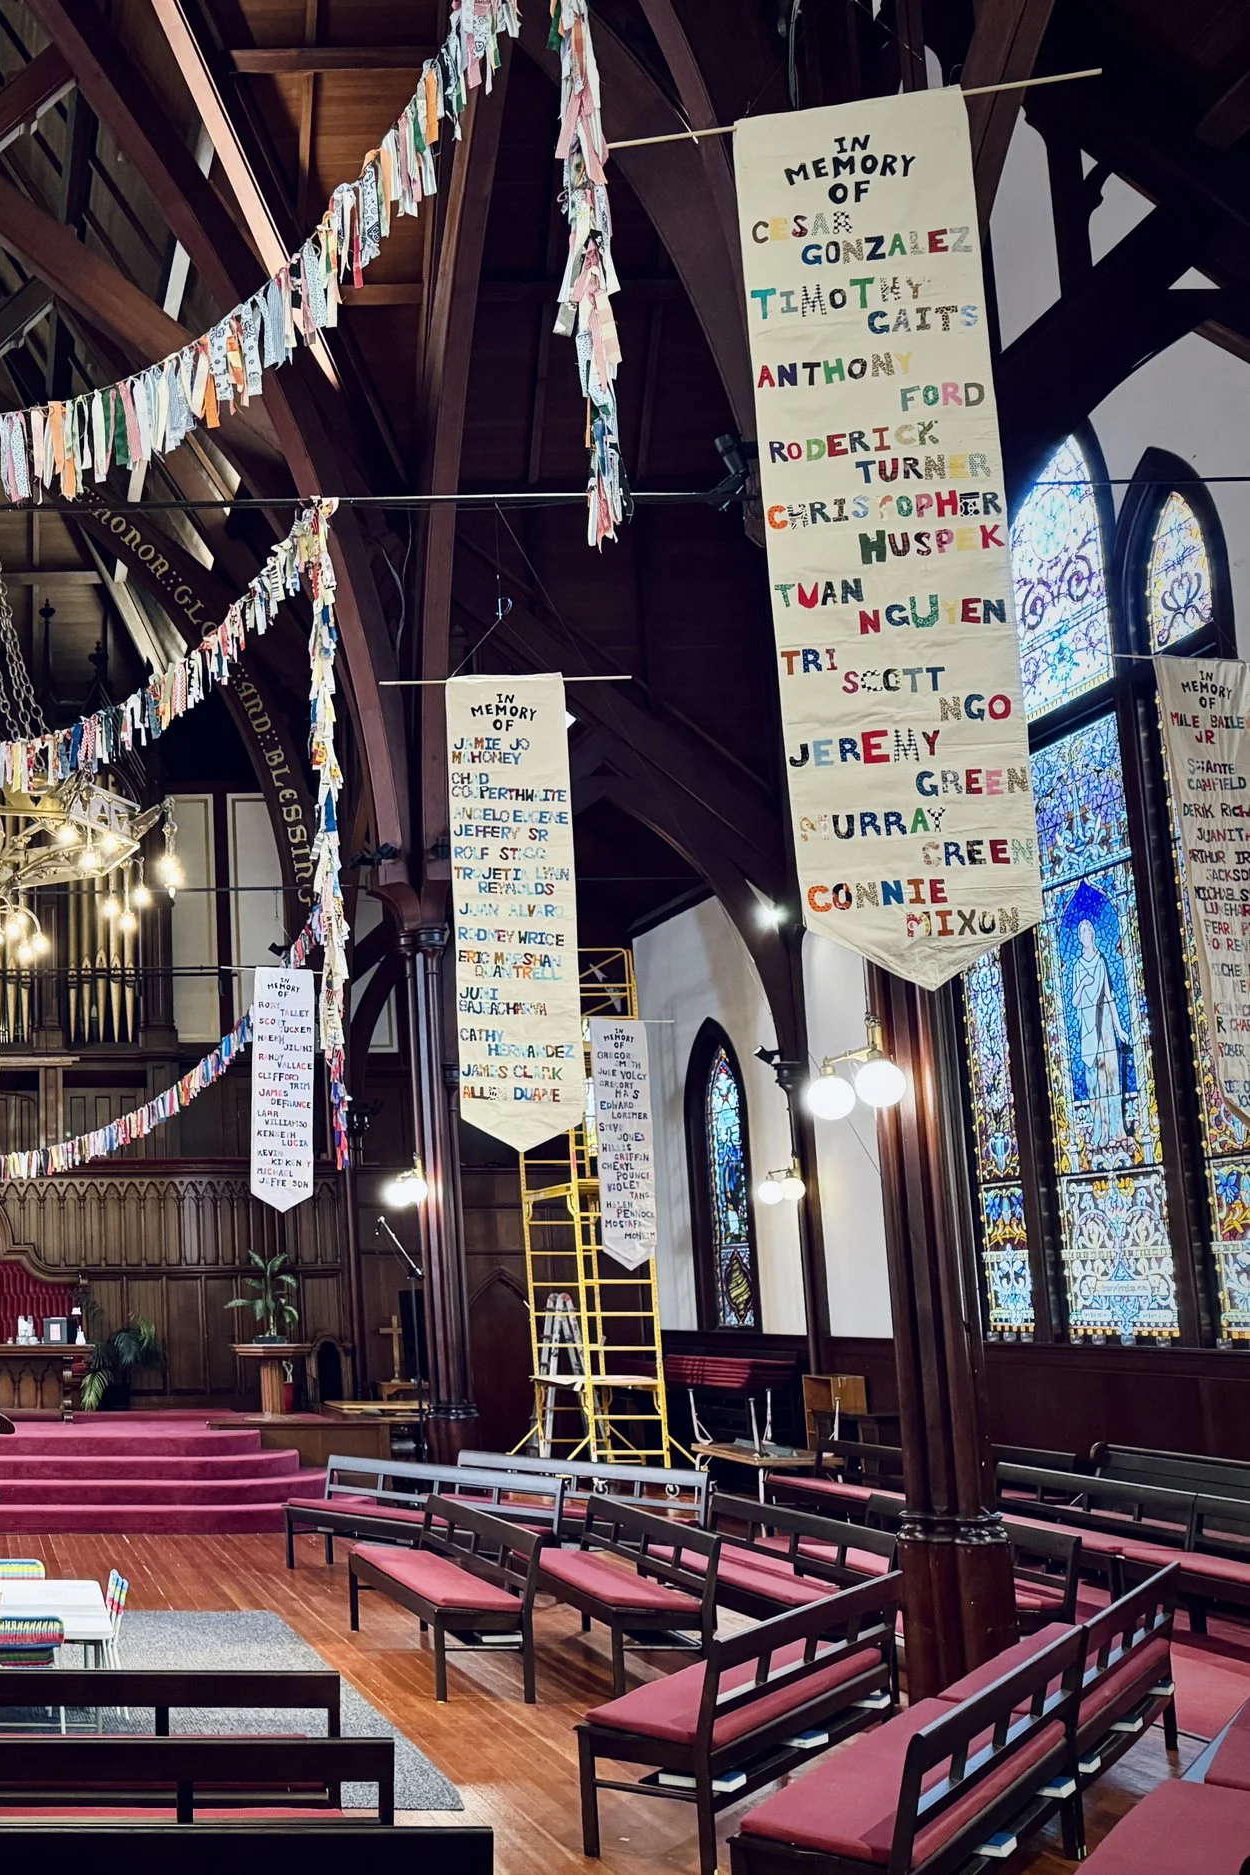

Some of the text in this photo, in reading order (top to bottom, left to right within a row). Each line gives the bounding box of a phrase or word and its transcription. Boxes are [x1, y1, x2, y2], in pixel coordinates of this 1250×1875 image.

[834, 135, 870, 153] IN
[785, 154, 916, 185] MEMORY
[828, 181, 870, 204] OF
[752, 211, 852, 243] CESAR
[801, 227, 973, 265] GONZALEZ
[751, 276, 930, 319] TIMOTHY
[868, 305, 978, 334] GAITS
[757, 351, 912, 388] ANTHONY
[900, 383, 984, 411] FORD
[769, 420, 939, 463] RODERICK
[856, 453, 991, 483] TURNER
[767, 489, 1002, 530] CHRISTOPHER
[860, 524, 1006, 564] HUSPEK
[775, 578, 863, 609] TUAN
[859, 594, 1006, 634] NGUYEN
[781, 648, 837, 675] TRI
[843, 667, 945, 693] SCOTT
[1200, 671, 1213, 681] IN
[496, 694, 515, 703] IN
[1181, 681, 1232, 700] MEMORY
[1200, 697, 1216, 709] OF
[471, 704, 537, 721] MEMORY
[939, 694, 1011, 721] NGO
[492, 719, 514, 731] OF
[1195, 729, 1216, 744] JR
[510, 738, 530, 750] JO
[789, 728, 940, 767] JEREMY
[916, 766, 1028, 796] GREEN
[454, 824, 548, 841] JEFFERY SR
[454, 846, 489, 859] ROLF
[922, 838, 1036, 867] GREEN
[807, 879, 948, 912] CONNIE
[906, 907, 1019, 937] MIXON
[458, 950, 490, 964] ERIC
[268, 983, 300, 993] MEMORY
[460, 1028, 504, 1041] CATHY
[604, 1034, 634, 1043] MEMORY
